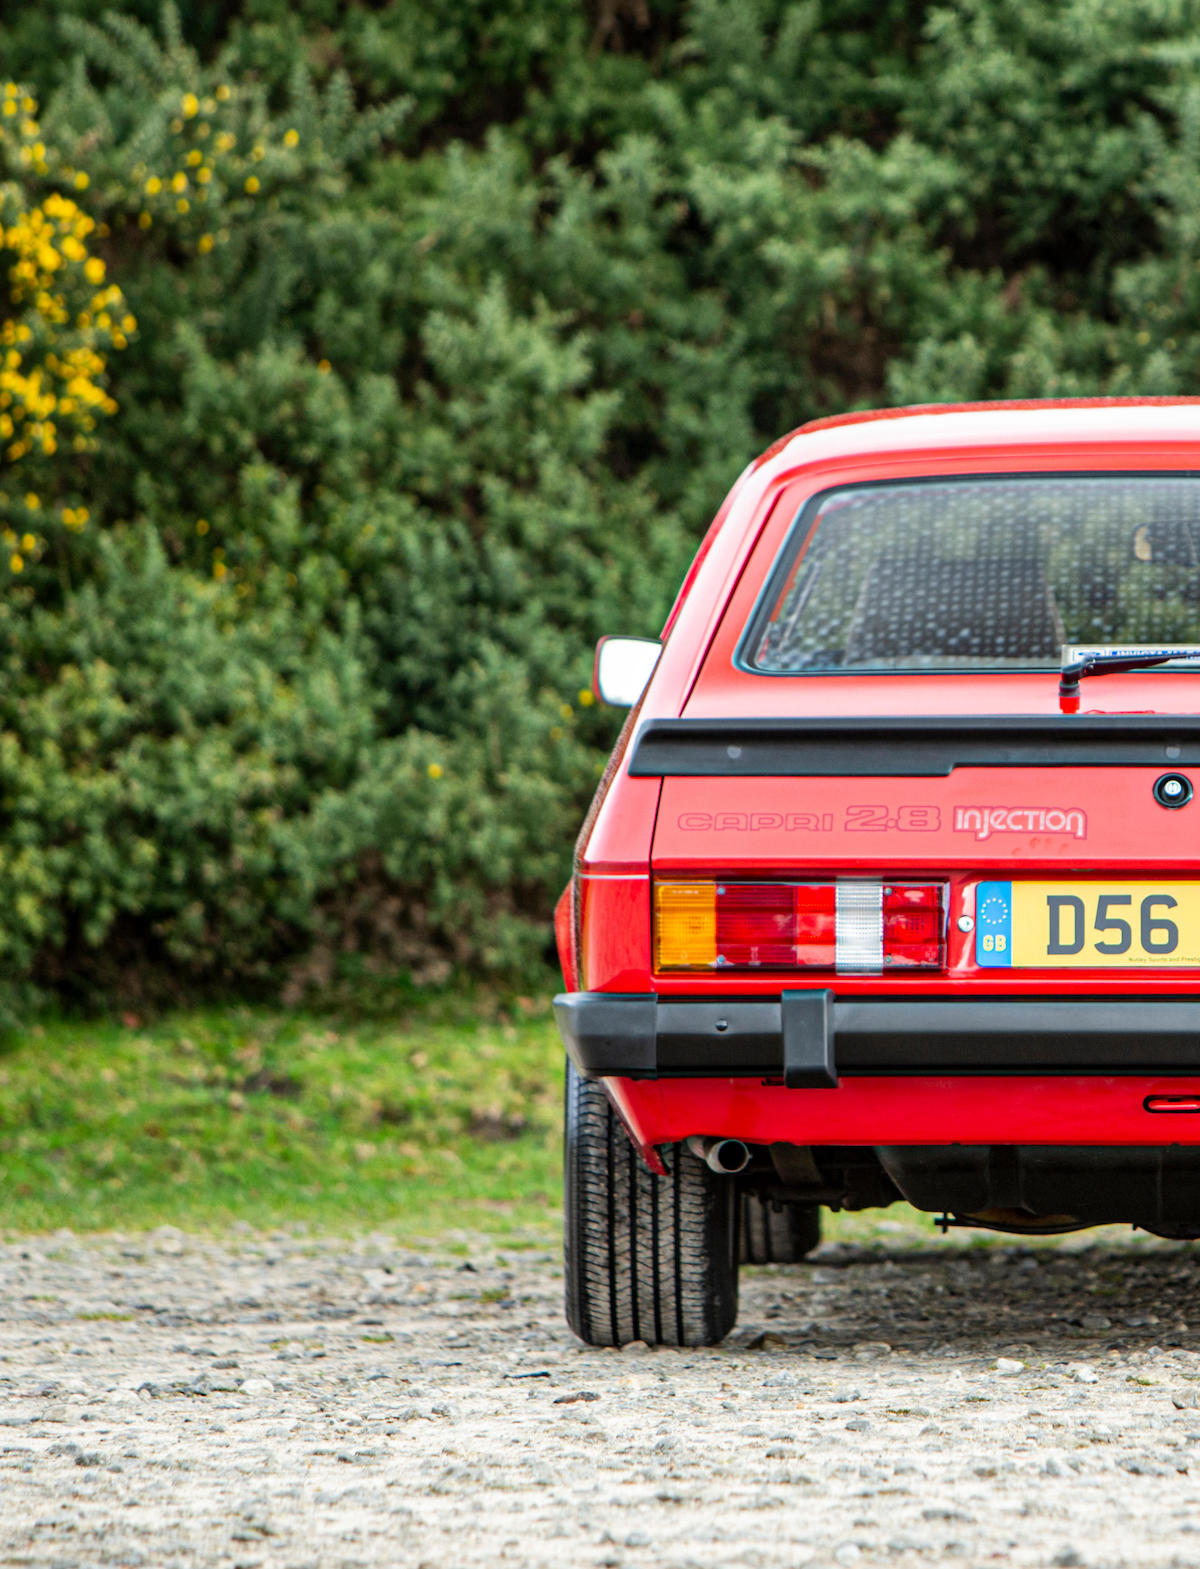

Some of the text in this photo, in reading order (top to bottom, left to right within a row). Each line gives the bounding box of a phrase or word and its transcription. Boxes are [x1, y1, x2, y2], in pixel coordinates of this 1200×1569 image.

[677, 812, 834, 832] CAPRI
[844, 805, 942, 832] 2.8
[1046, 894, 1179, 955] D56
[982, 934, 1007, 952] GB
